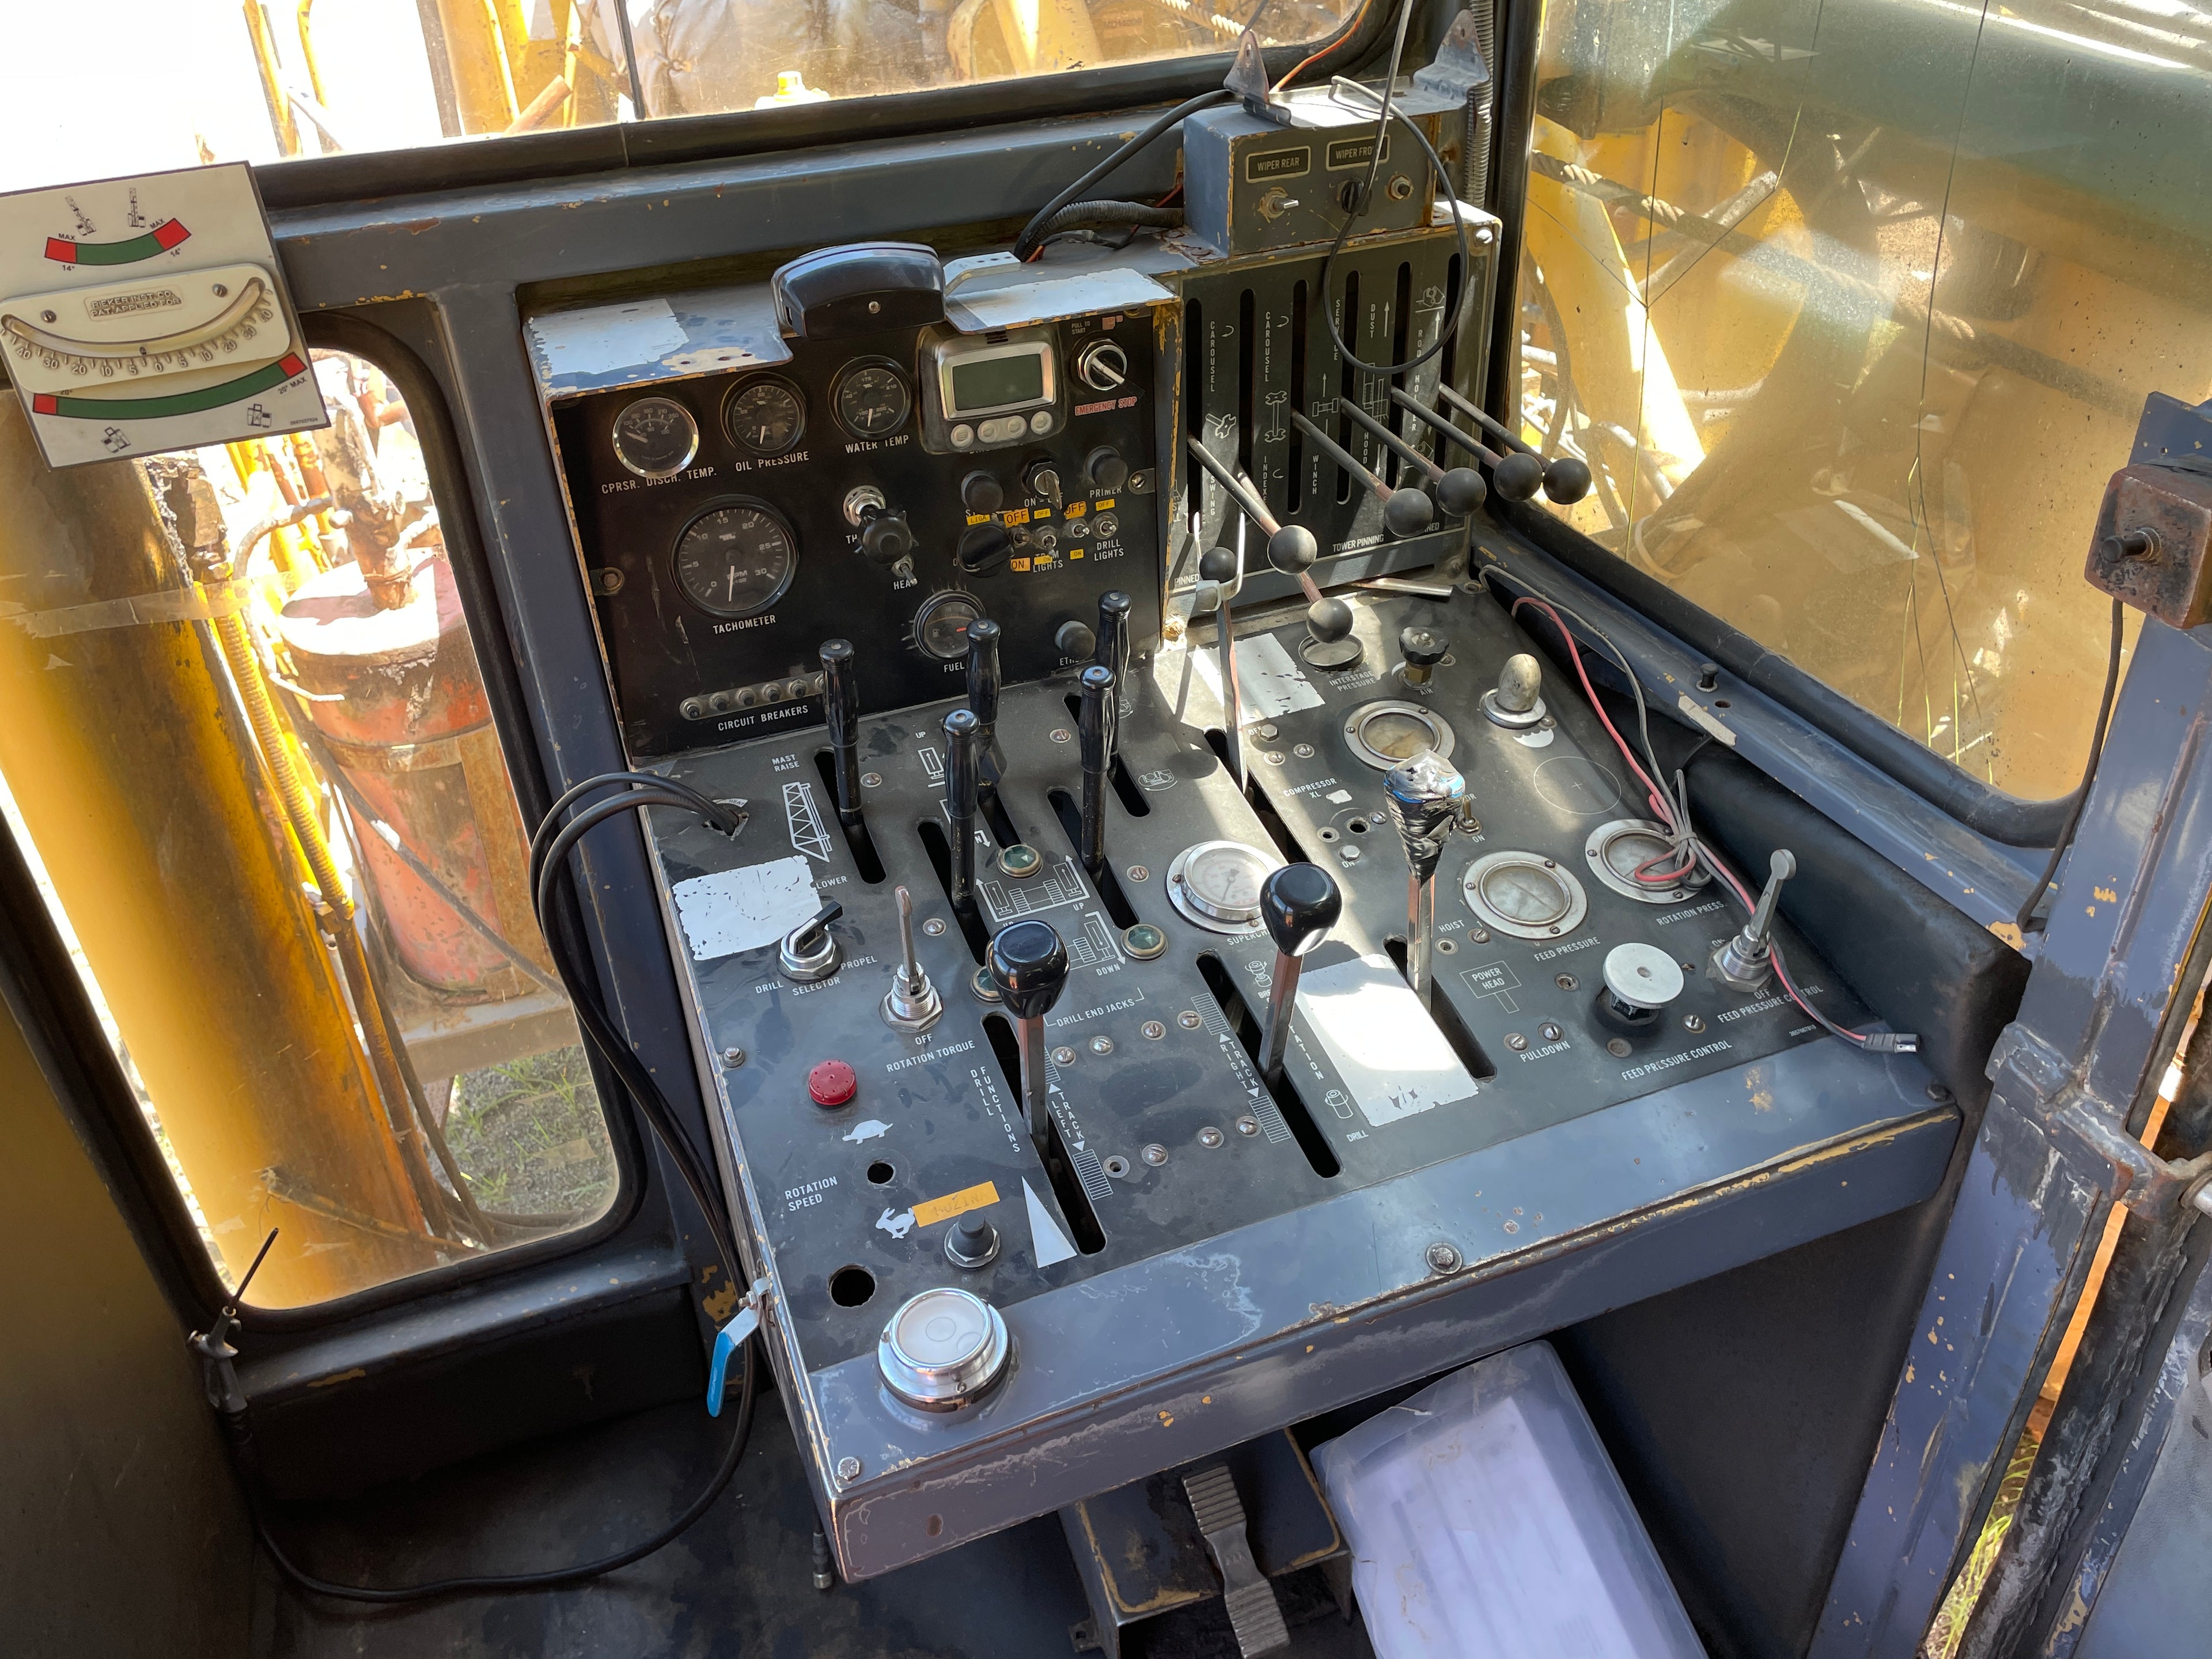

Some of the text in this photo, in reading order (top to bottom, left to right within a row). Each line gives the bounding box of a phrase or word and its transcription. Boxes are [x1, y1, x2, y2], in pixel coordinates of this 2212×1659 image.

[1335, 145, 1374, 160] WIPER FRO
[1257, 157, 1300, 171] WIPER REAR
[150, 218, 165, 229] MAX
[58, 233, 75, 241] MAX
[92, 296, 128, 309] RIEKER
[116, 301, 158, 314] APPLIED
[160, 298, 181, 306] FOR
[16, 347, 31, 360] 40
[200, 351, 213, 361] 10
[43, 357, 59, 369] 30
[71, 365, 87, 374] 20
[154, 363, 164, 372] 0
[101, 366, 113, 377] 10
[128, 365, 138, 375] 5
[290, 377, 307, 388] MAX
[1075, 396, 1137, 416] EMERGENCY STOP
[845, 434, 909, 454] WATER TEMP
[735, 451, 809, 472] OIL PRESSURE
[601, 479, 641, 494] CPRSR.
[687, 467, 717, 480] TEMP.
[1090, 487, 1122, 499] PRIMER
[1024, 499, 1036, 507] ON
[717, 517, 729, 525] 15
[1006, 511, 1028, 524] OFF
[742, 521, 755, 530] 20
[759, 543, 771, 551] 25
[1096, 539, 1121, 551] DRILL
[1332, 534, 1384, 552] TOWER PINNING
[1094, 548, 1124, 562] LIGHTS
[1012, 560, 1025, 570] ON
[1033, 560, 1063, 573] LIGHTS
[755, 568, 767, 576] 30
[893, 579, 911, 590] HEA
[1175, 573, 1200, 585] PINNED
[713, 615, 776, 634] TACHOMETER
[944, 661, 965, 673] FUEL
[1329, 671, 1373, 686] INTERSTAGE
[1337, 678, 1376, 692] PRESSURE
[1419, 687, 1433, 696] AIR
[718, 706, 808, 732] CIRCUIT BREAKERS
[915, 730, 927, 739] UP
[772, 754, 796, 766] MAST
[774, 761, 800, 772] RAISE
[1283, 778, 1338, 797] COMPRESSOR
[1309, 790, 1321, 799] XL
[1472, 835, 1485, 843] ON
[816, 876, 848, 890] LOWER
[1073, 903, 1085, 912] UP
[1656, 907, 1697, 926] ROTATION
[1438, 919, 1465, 933] HOIST
[1533, 937, 1601, 961] FEED PRESSURE
[840, 956, 877, 971] PROPEL
[1096, 963, 1121, 976] DOWN
[1471, 967, 1502, 982] POWER
[755, 981, 783, 994] DRILL
[792, 977, 841, 996] SELECTOR
[1482, 978, 1505, 990] HEAD
[1754, 988, 1771, 999] OFF
[1717, 985, 1824, 1023] FEED PRESSURE COTROL
[1056, 998, 1135, 1027] DRILL END JACKS
[915, 1034, 932, 1046] OFF
[885, 1040, 975, 1073] ROTATION TORQUE
[1289, 1025, 1324, 1080] TATION
[1519, 1040, 1571, 1062] PULLDOWN
[1220, 1044, 1248, 1089] RIGHT
[1229, 1041, 1259, 1086] TRACK
[1621, 1040, 1732, 1081] FEED PRESSURE CONTROL
[970, 1069, 994, 1116] DRILL
[980, 1066, 1021, 1153] FUNCTIONS
[1058, 1092, 1084, 1140] TRACK
[1051, 1101, 1071, 1138] LEFT
[1346, 1130, 1369, 1142] DRILL
[785, 1176, 838, 1199] ROTATION
[788, 1193, 823, 1211] SPEED
